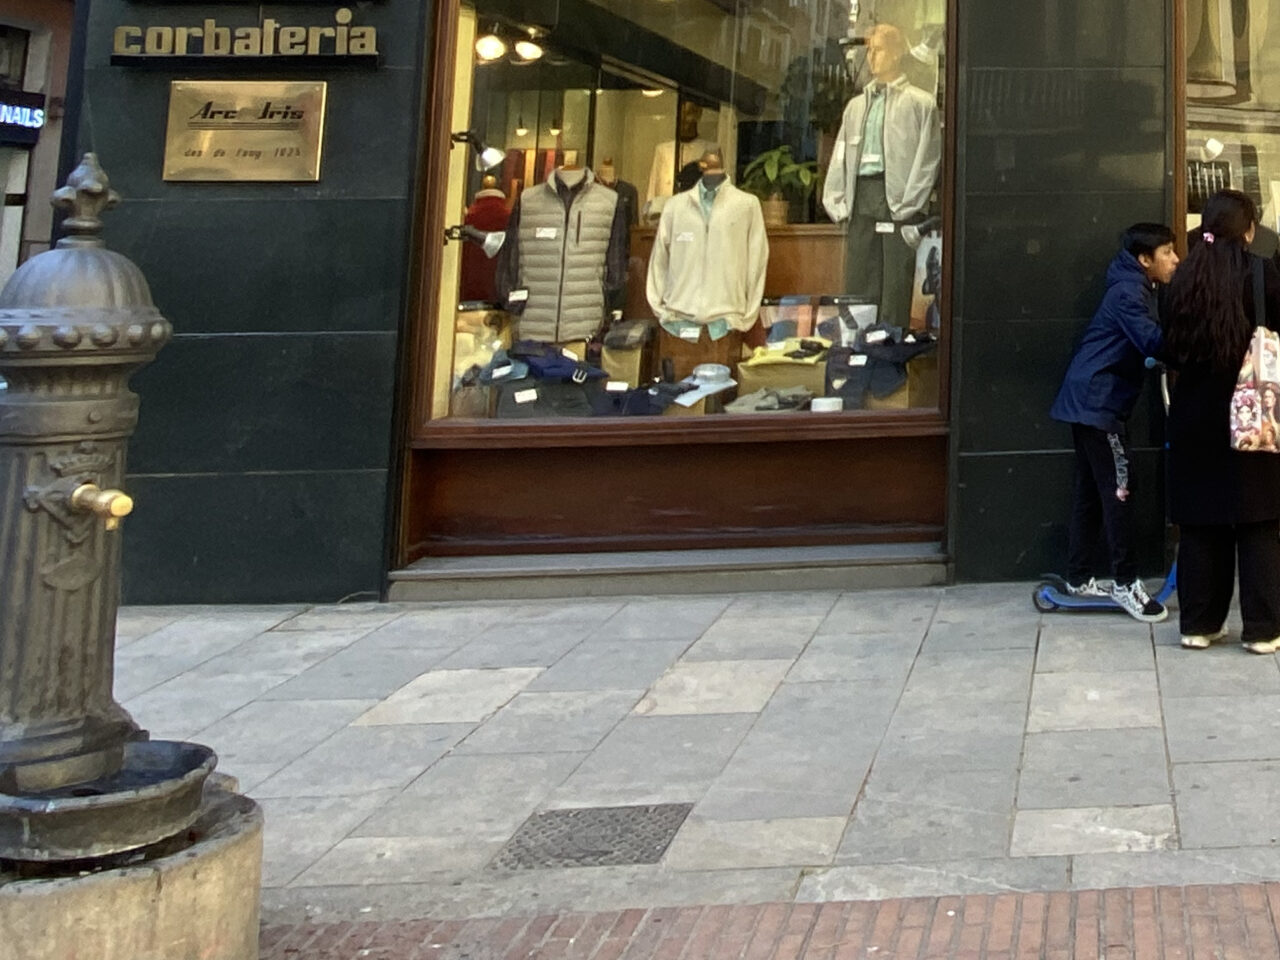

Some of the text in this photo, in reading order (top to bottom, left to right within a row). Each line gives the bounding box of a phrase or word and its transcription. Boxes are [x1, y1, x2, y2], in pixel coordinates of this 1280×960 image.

[113, 7, 378, 56] corbateria
[0, 104, 44, 128] NAILS
[189, 101, 305, 120] Arc Iris
